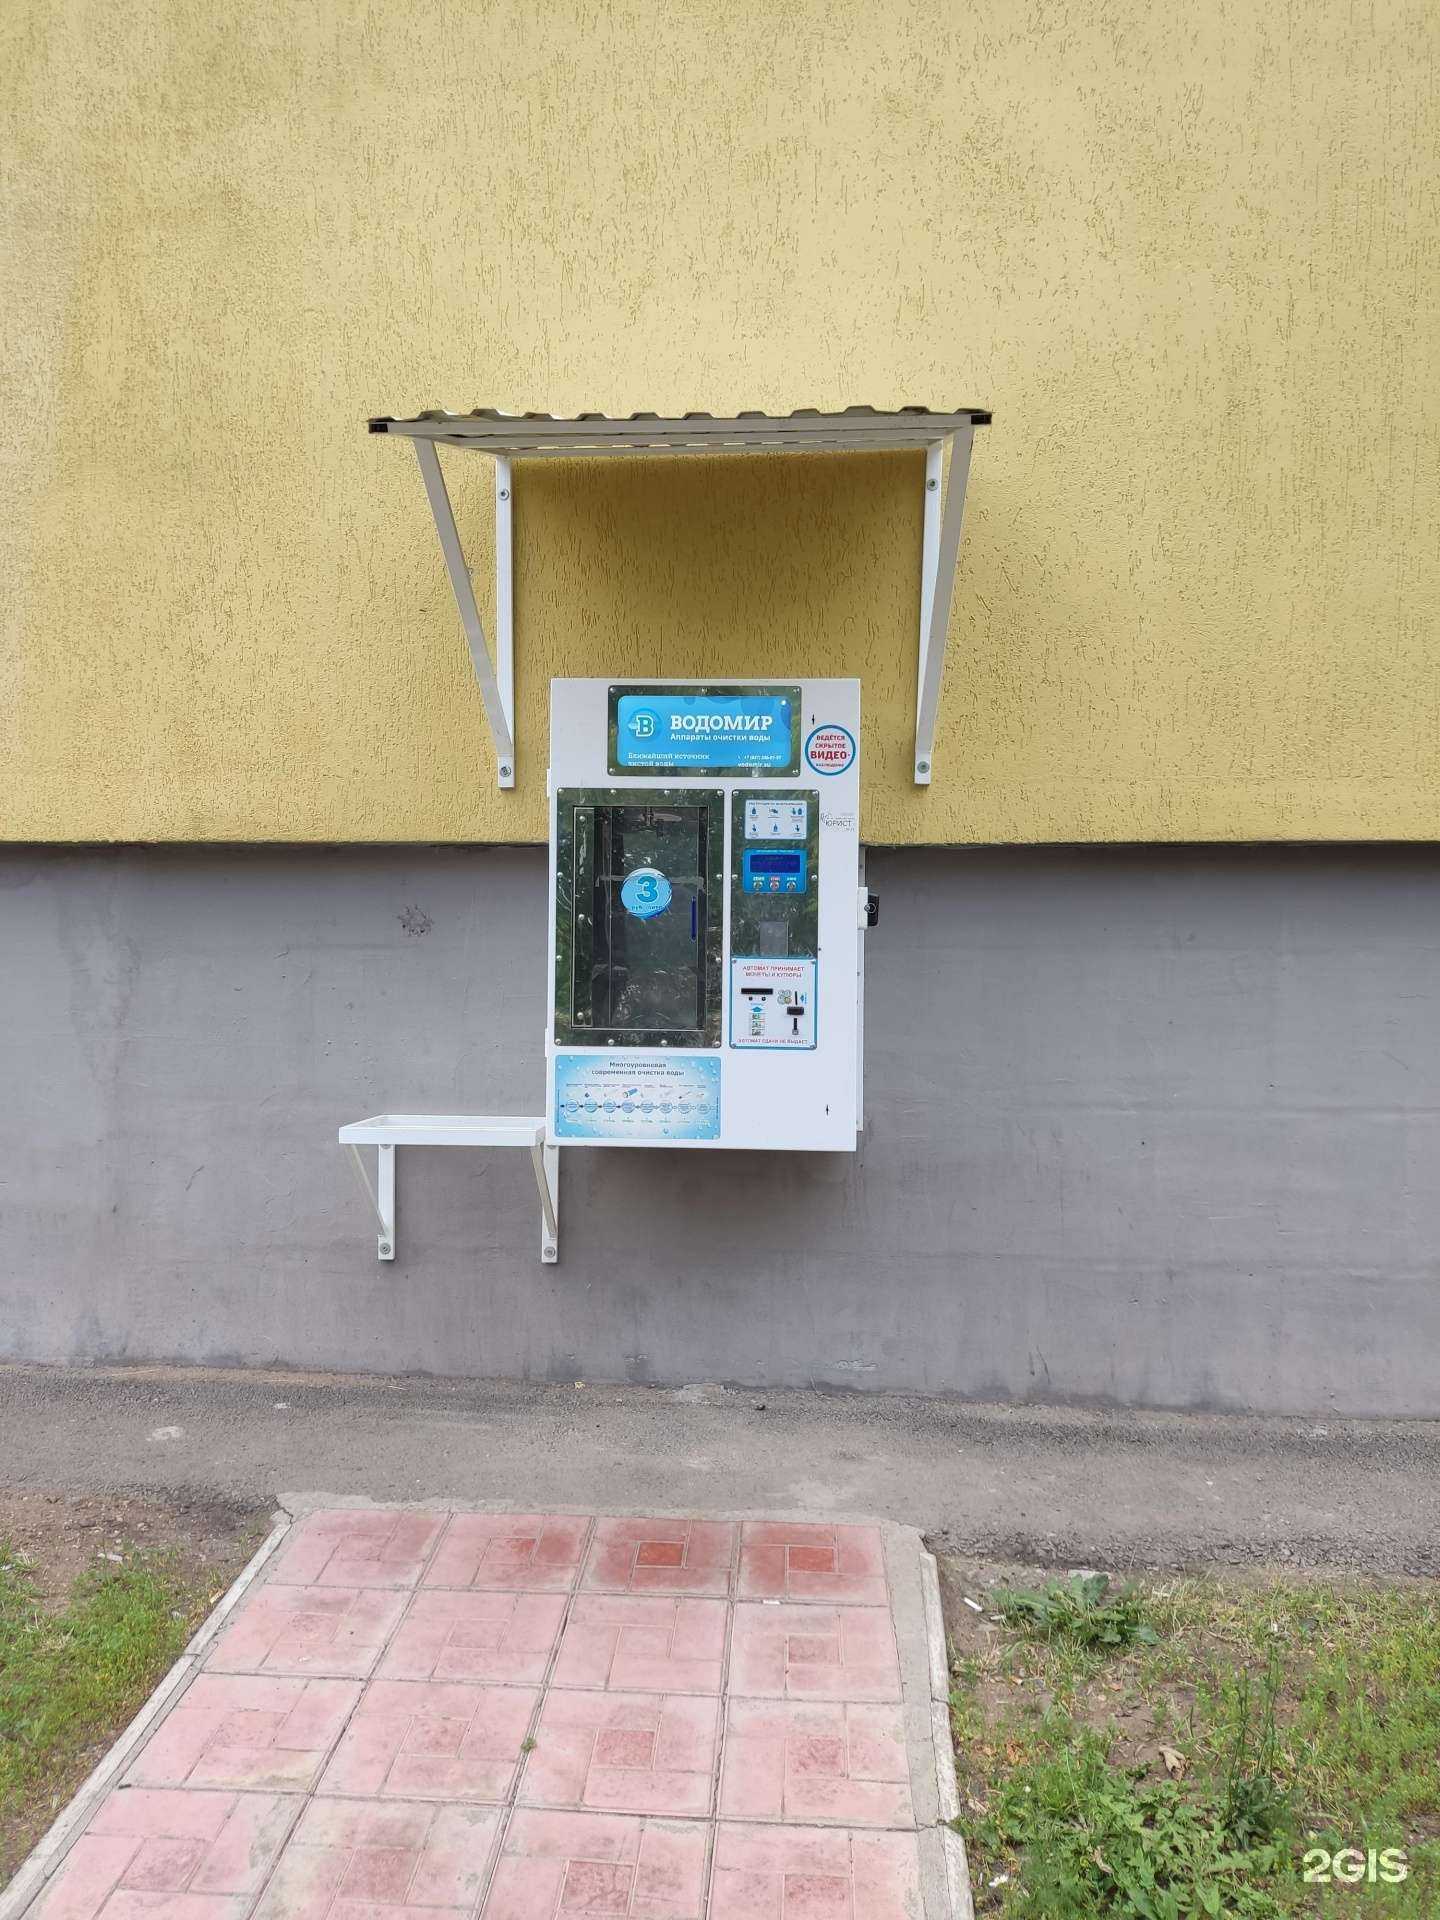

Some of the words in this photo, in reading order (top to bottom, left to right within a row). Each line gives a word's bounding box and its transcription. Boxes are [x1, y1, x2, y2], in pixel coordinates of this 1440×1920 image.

[670, 715, 772, 733] ВОДОМИР
[670, 733, 711, 742] Аппараты
[749, 734, 771, 742] воды
[636, 875, 658, 903] 3
[609, 1061, 667, 1069] Многоуровневая
